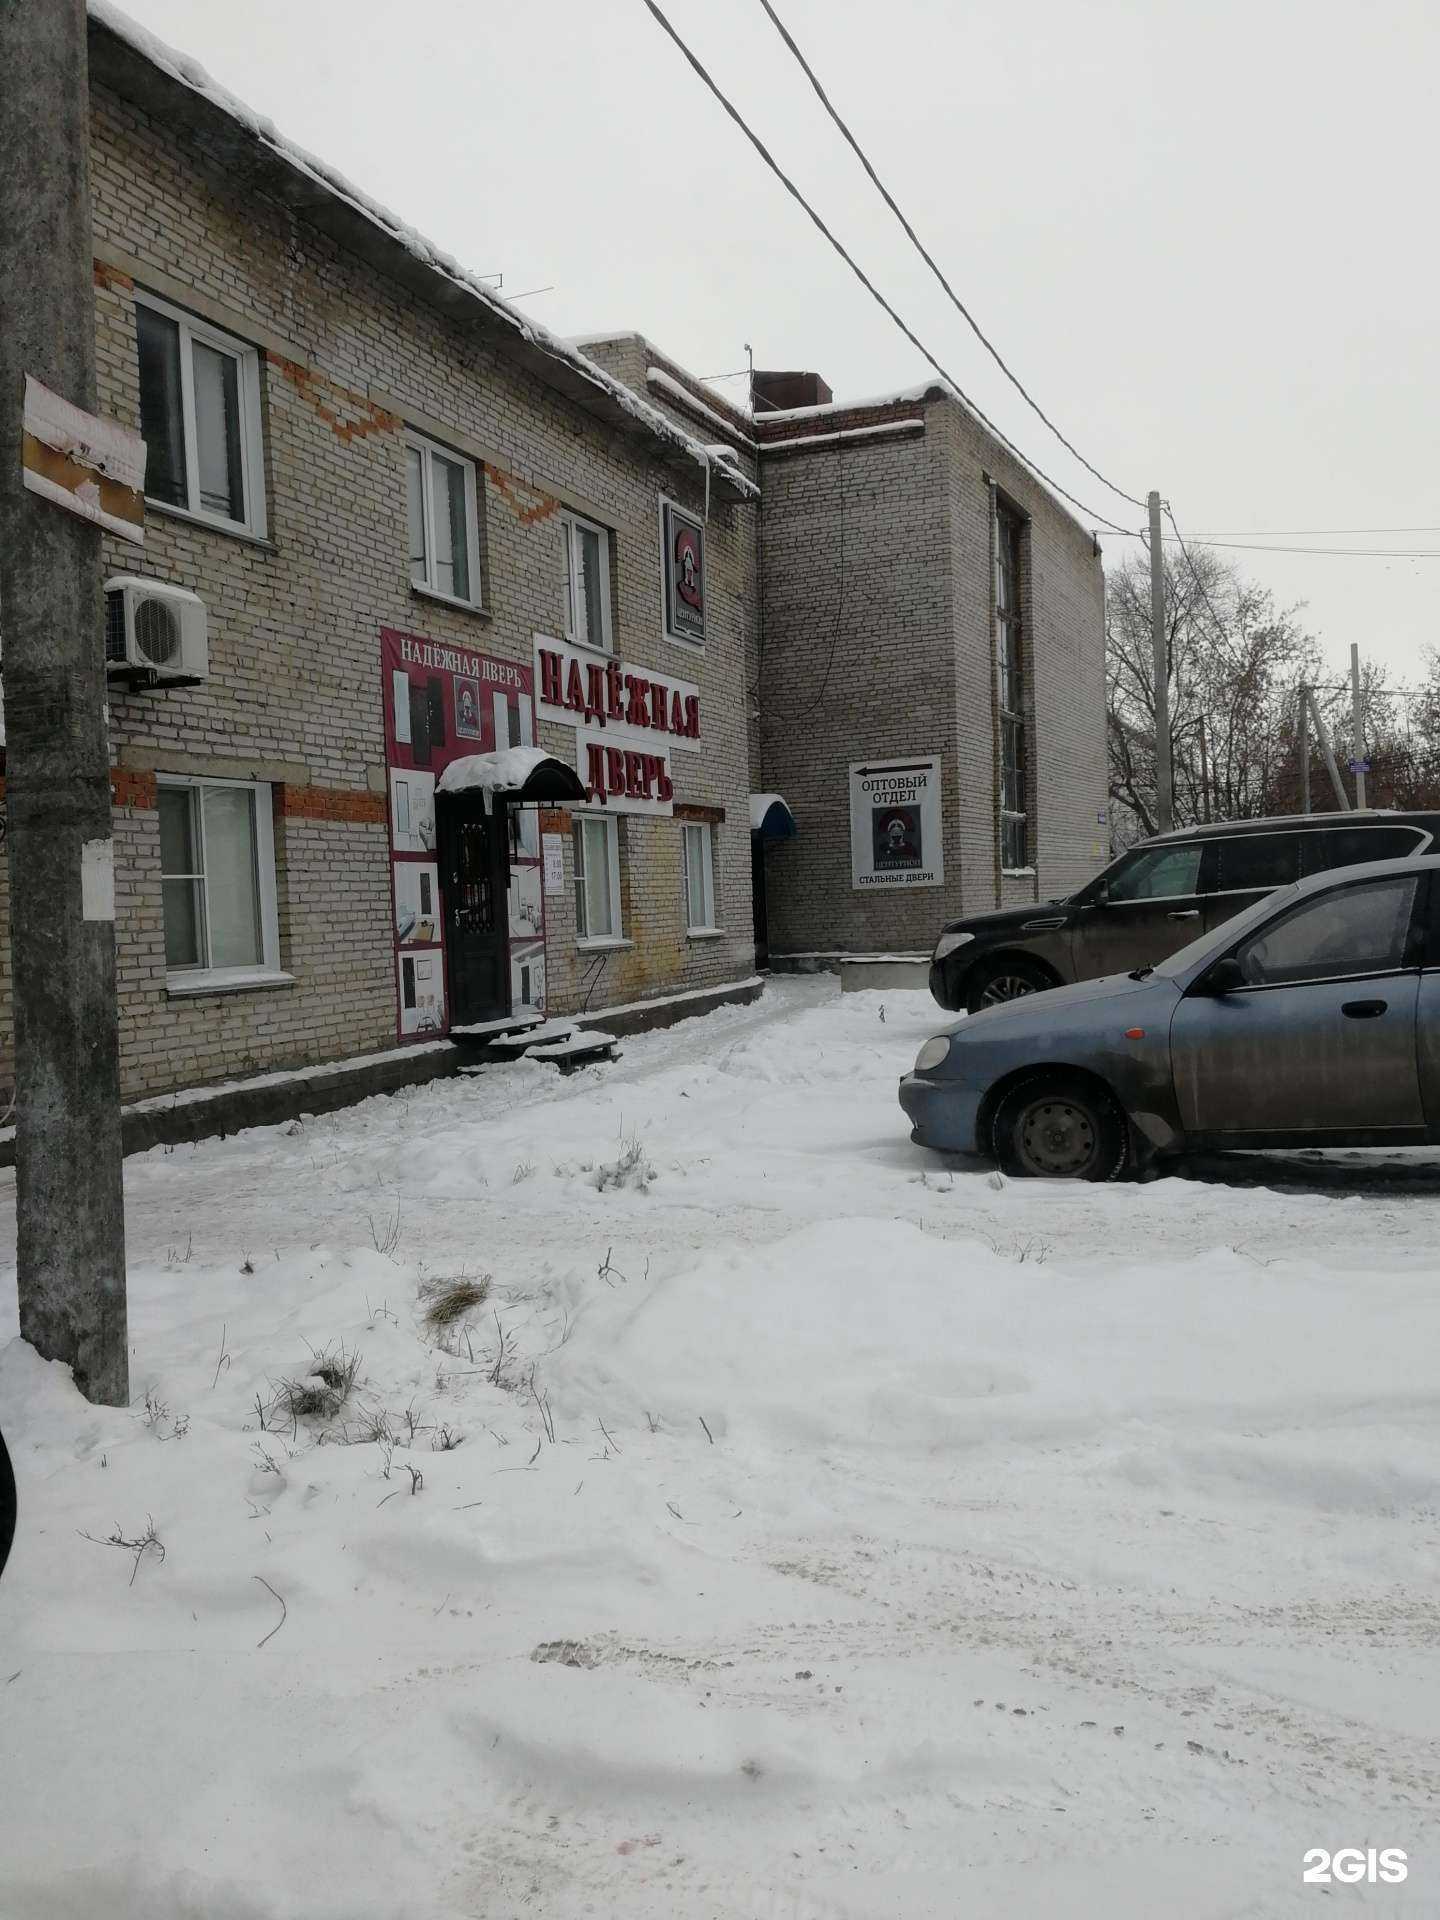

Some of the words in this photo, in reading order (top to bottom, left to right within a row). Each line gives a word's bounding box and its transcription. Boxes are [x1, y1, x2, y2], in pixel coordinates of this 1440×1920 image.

[400, 639, 480, 678] НАДЁЖНАЯ
[482, 660, 522, 688] ДВЕРЬ
[538, 649, 701, 739] НАДЁЖНАЯ
[586, 743, 674, 805] ДВЕРЬ
[861, 774, 928, 791] ОПТОВЫЙ
[872, 790, 917, 804] ОТДЕЛ
[859, 874, 905, 884] СТАЛЬНЫЕ
[906, 872, 934, 883] ДВЕРИ
